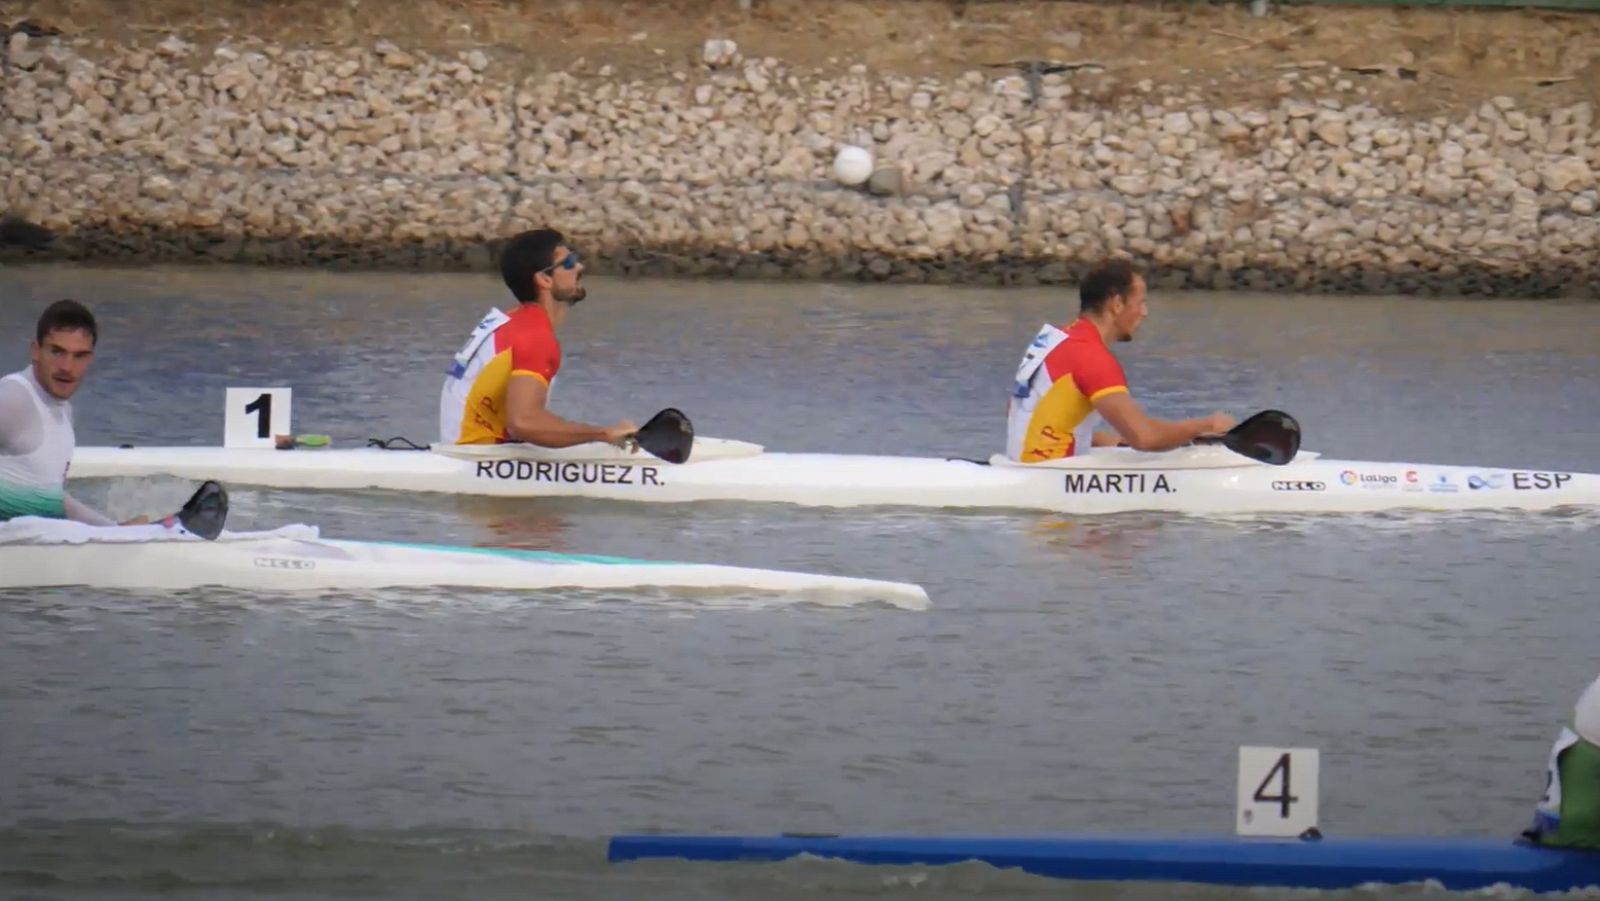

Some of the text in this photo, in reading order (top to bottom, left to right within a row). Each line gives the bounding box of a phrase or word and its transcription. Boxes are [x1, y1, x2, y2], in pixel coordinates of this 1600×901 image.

[244, 393, 272, 438] 1
[476, 460, 666, 486] RODRIGUEZ R.
[1065, 474, 1177, 493] MARTI A.
[1512, 472, 1572, 490] ESP
[1253, 752, 1299, 819] 4
